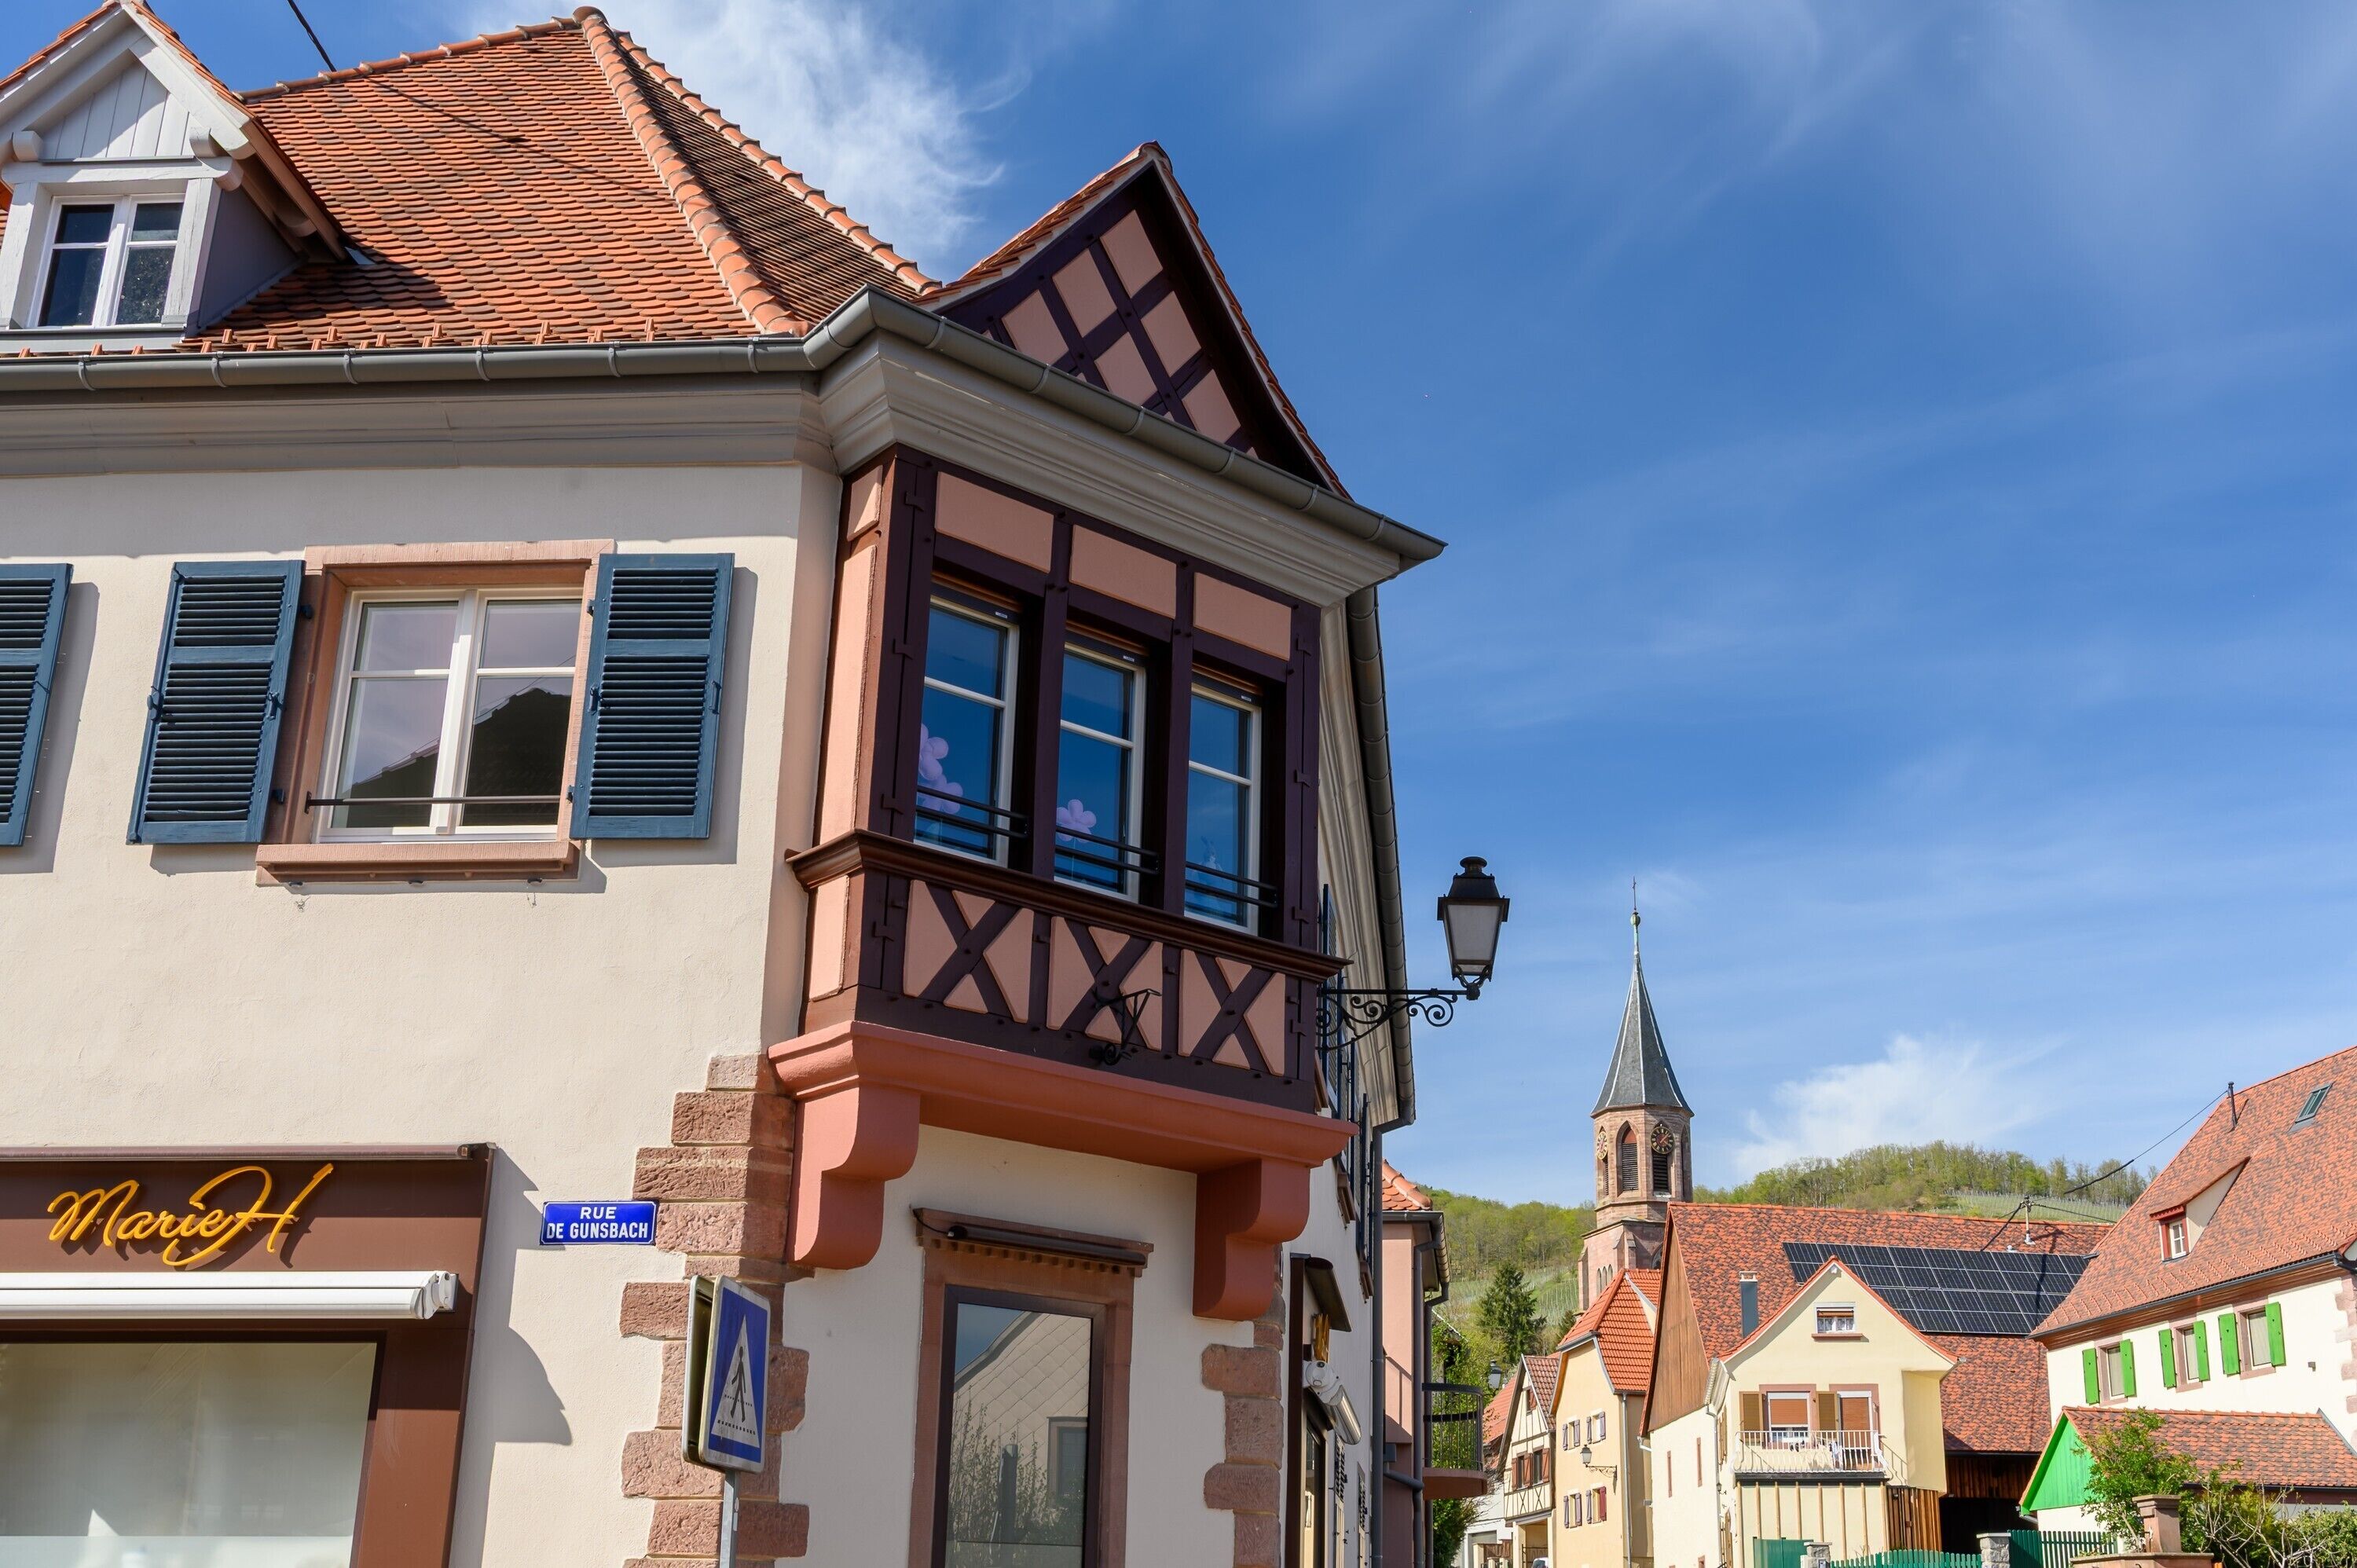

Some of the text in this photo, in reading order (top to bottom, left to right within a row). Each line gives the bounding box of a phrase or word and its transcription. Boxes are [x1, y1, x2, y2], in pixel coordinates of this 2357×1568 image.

[580, 1206, 618, 1219] RUE
[546, 1222, 648, 1239] DE GUNSBACH
